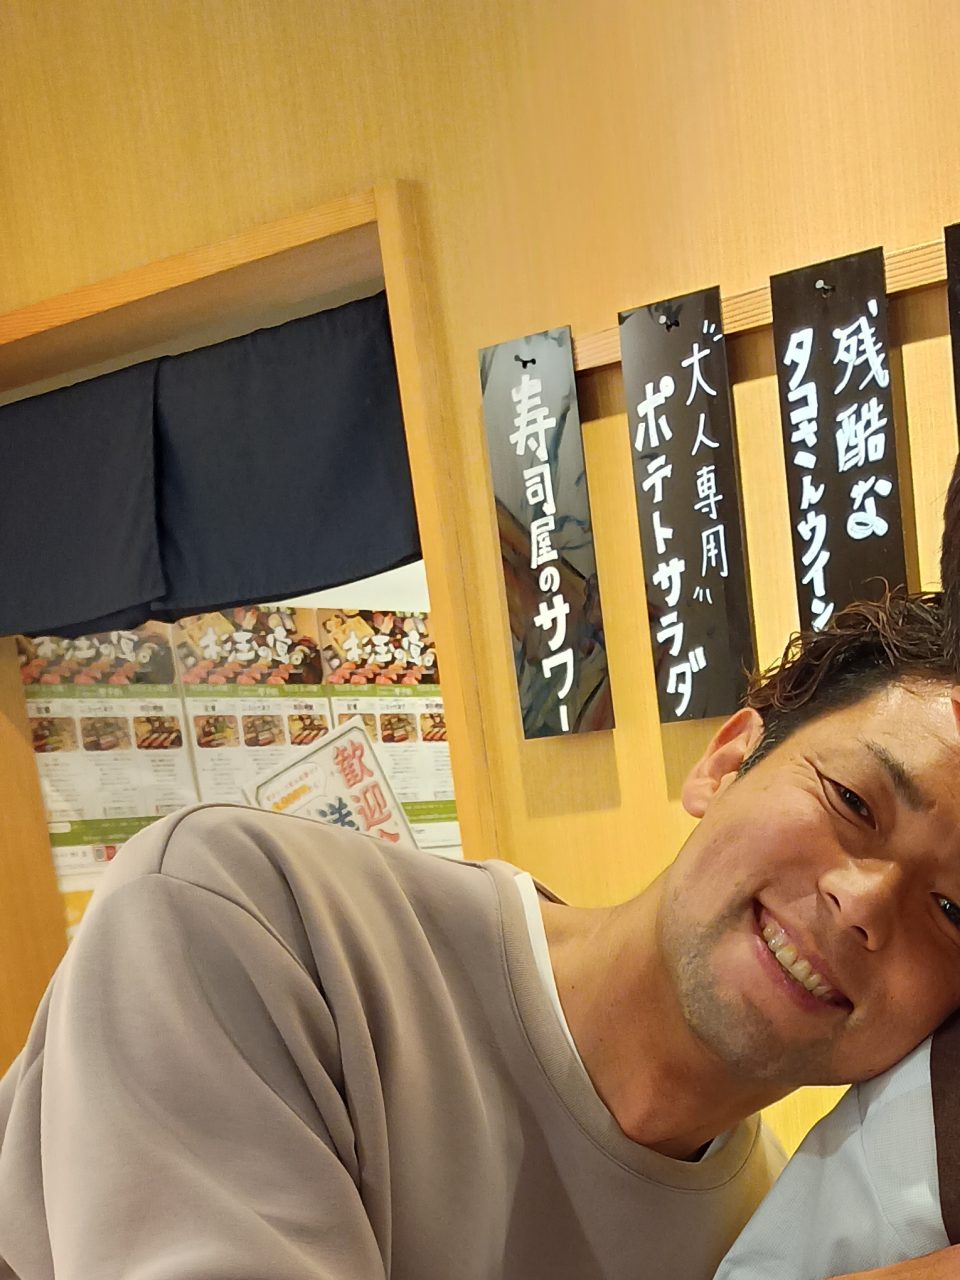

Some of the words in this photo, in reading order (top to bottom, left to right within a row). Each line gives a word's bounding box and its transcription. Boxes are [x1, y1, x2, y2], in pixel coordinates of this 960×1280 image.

[508, 374, 574, 732] 寿司屋のサワー
[635, 375, 707, 718] ポテトサラダ
[832, 299, 890, 540] 残酷な
[334, 739, 400, 844] 歓迎
